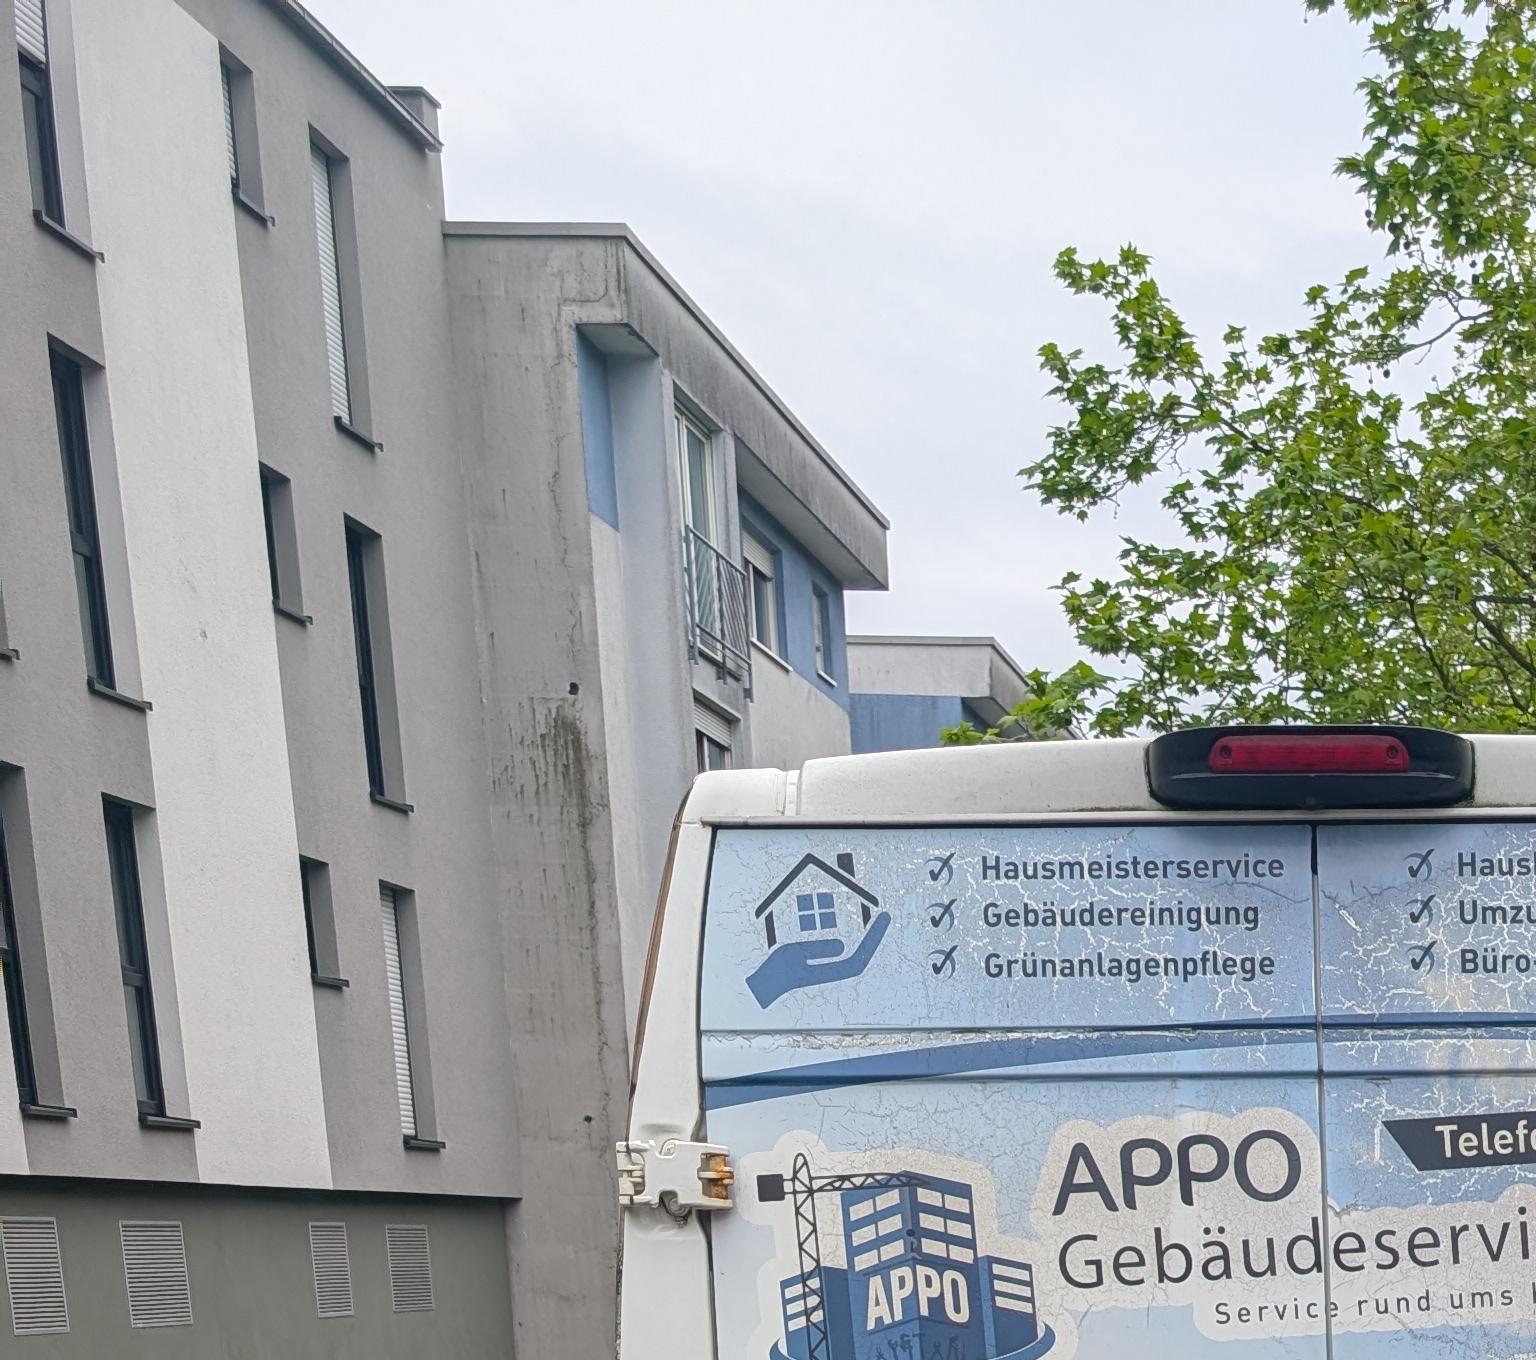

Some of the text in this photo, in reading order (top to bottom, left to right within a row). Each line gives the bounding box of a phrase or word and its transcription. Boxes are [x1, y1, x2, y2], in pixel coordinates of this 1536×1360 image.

[981, 853, 1285, 882] Hausmeisterservice
[983, 901, 1260, 932] Gebäudereinigung
[985, 949, 1276, 983] Grünanlagenpflege
[1051, 1129, 1302, 1217] APPO
[865, 1265, 971, 1331] APPO
[1215, 1296, 1340, 1326] Service
[1357, 1287, 1432, 1317] rund
[1449, 1288, 1514, 1312] ums
